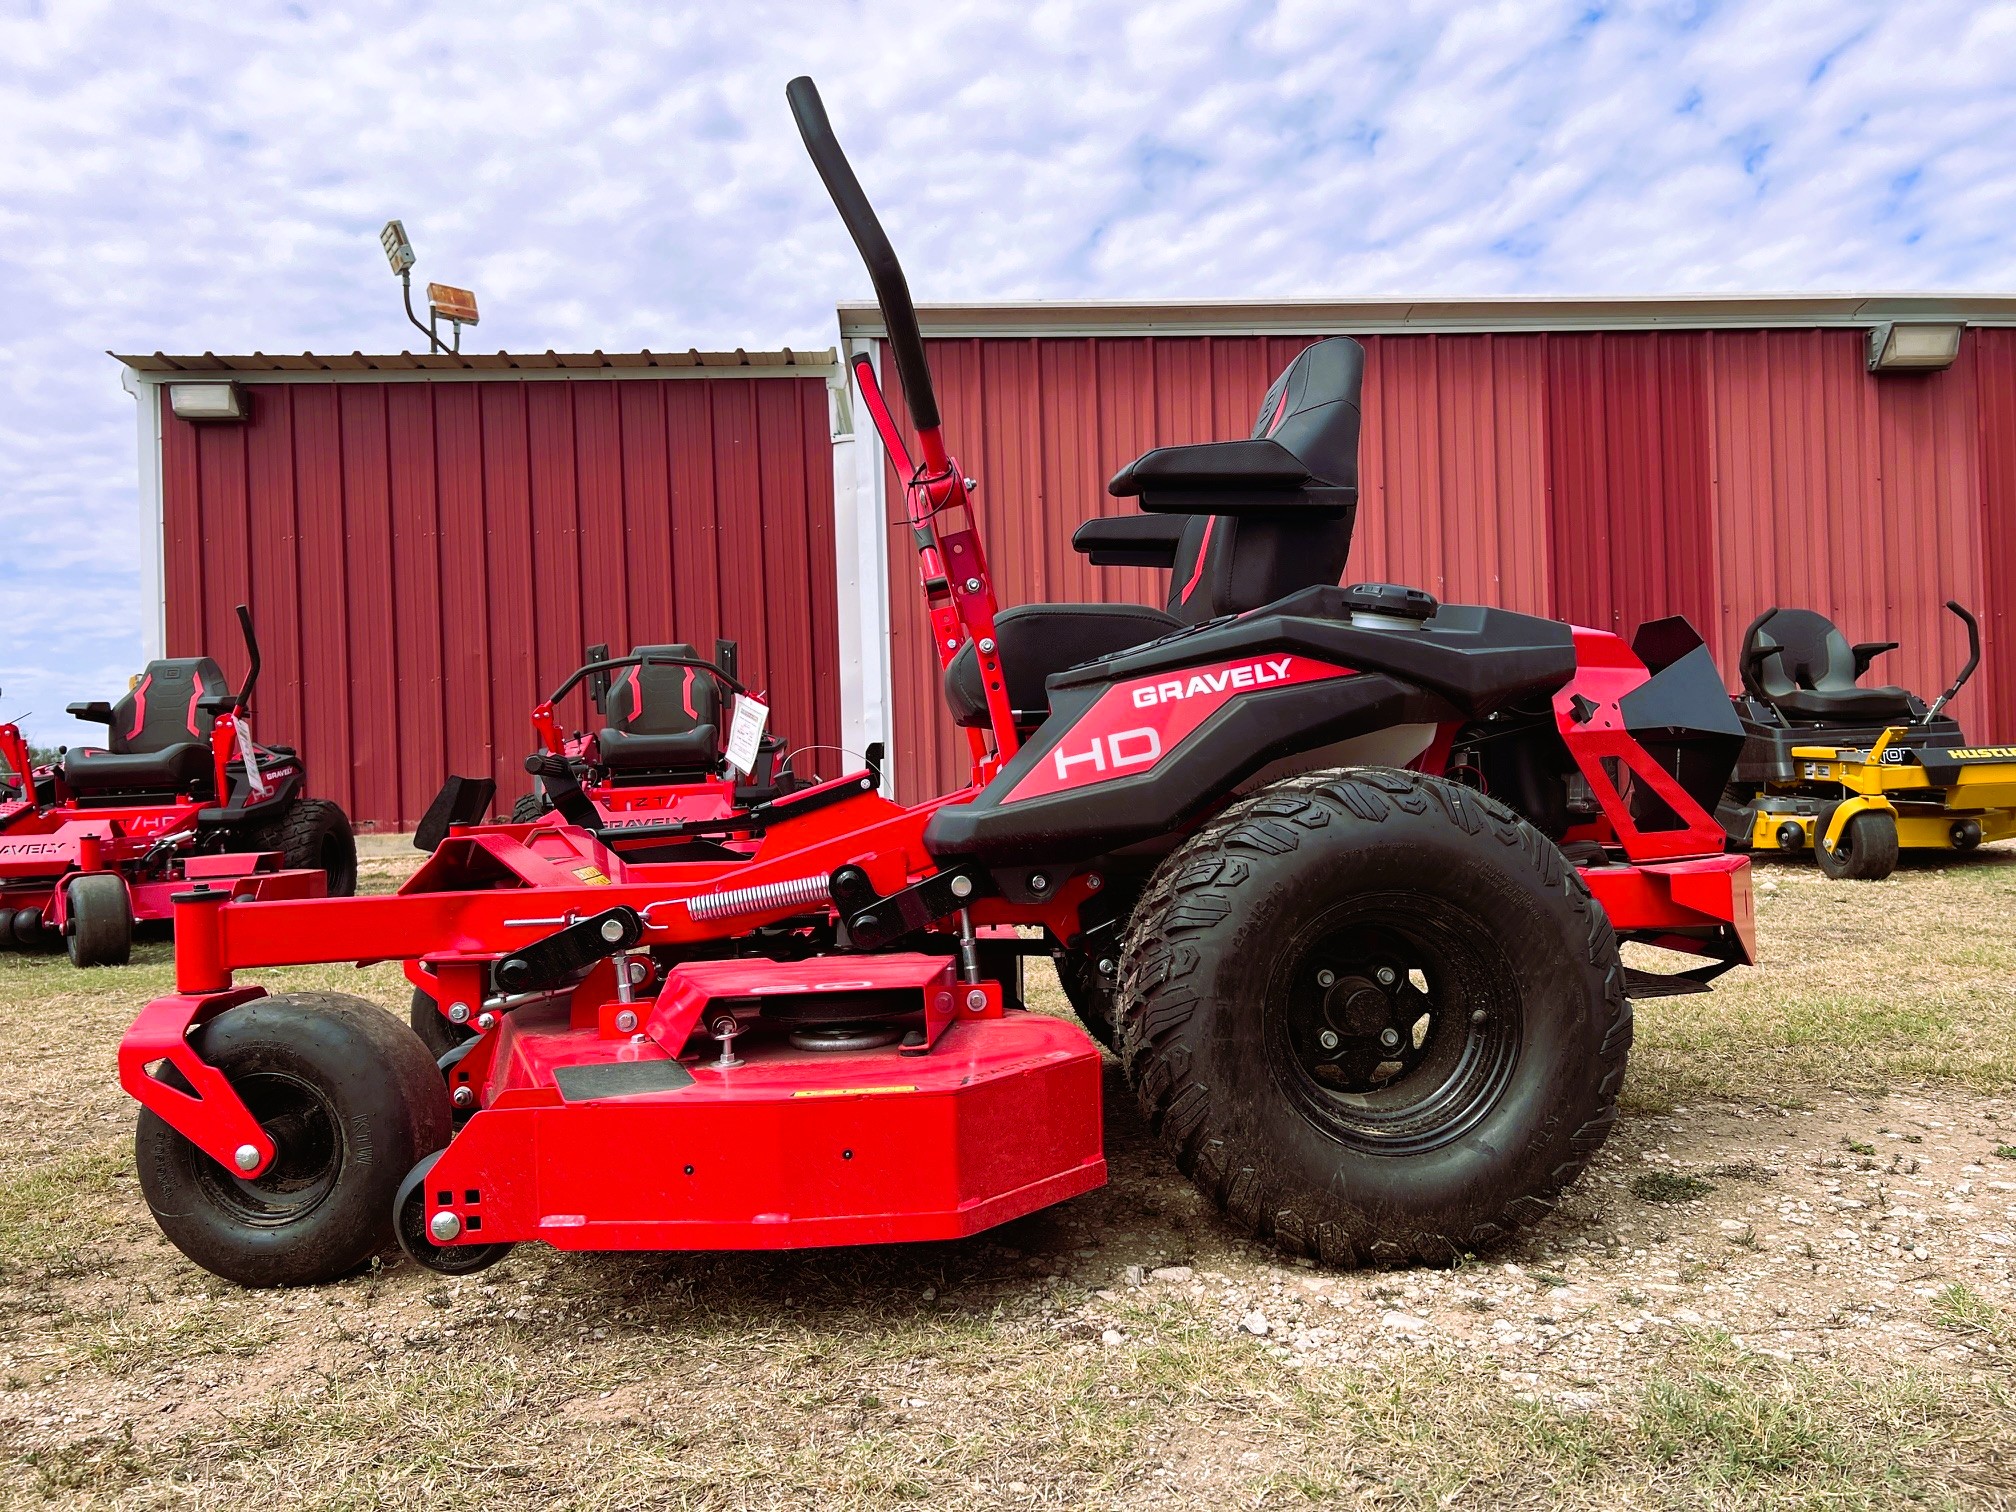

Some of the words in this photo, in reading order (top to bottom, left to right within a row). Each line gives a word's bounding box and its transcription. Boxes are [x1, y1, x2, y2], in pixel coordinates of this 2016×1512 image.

[1133, 657, 1292, 709] GRAVELY
[266, 766, 293, 780] GRAVELY
[1054, 726, 1162, 780] HD
[352, 1113, 374, 1166] KTW
